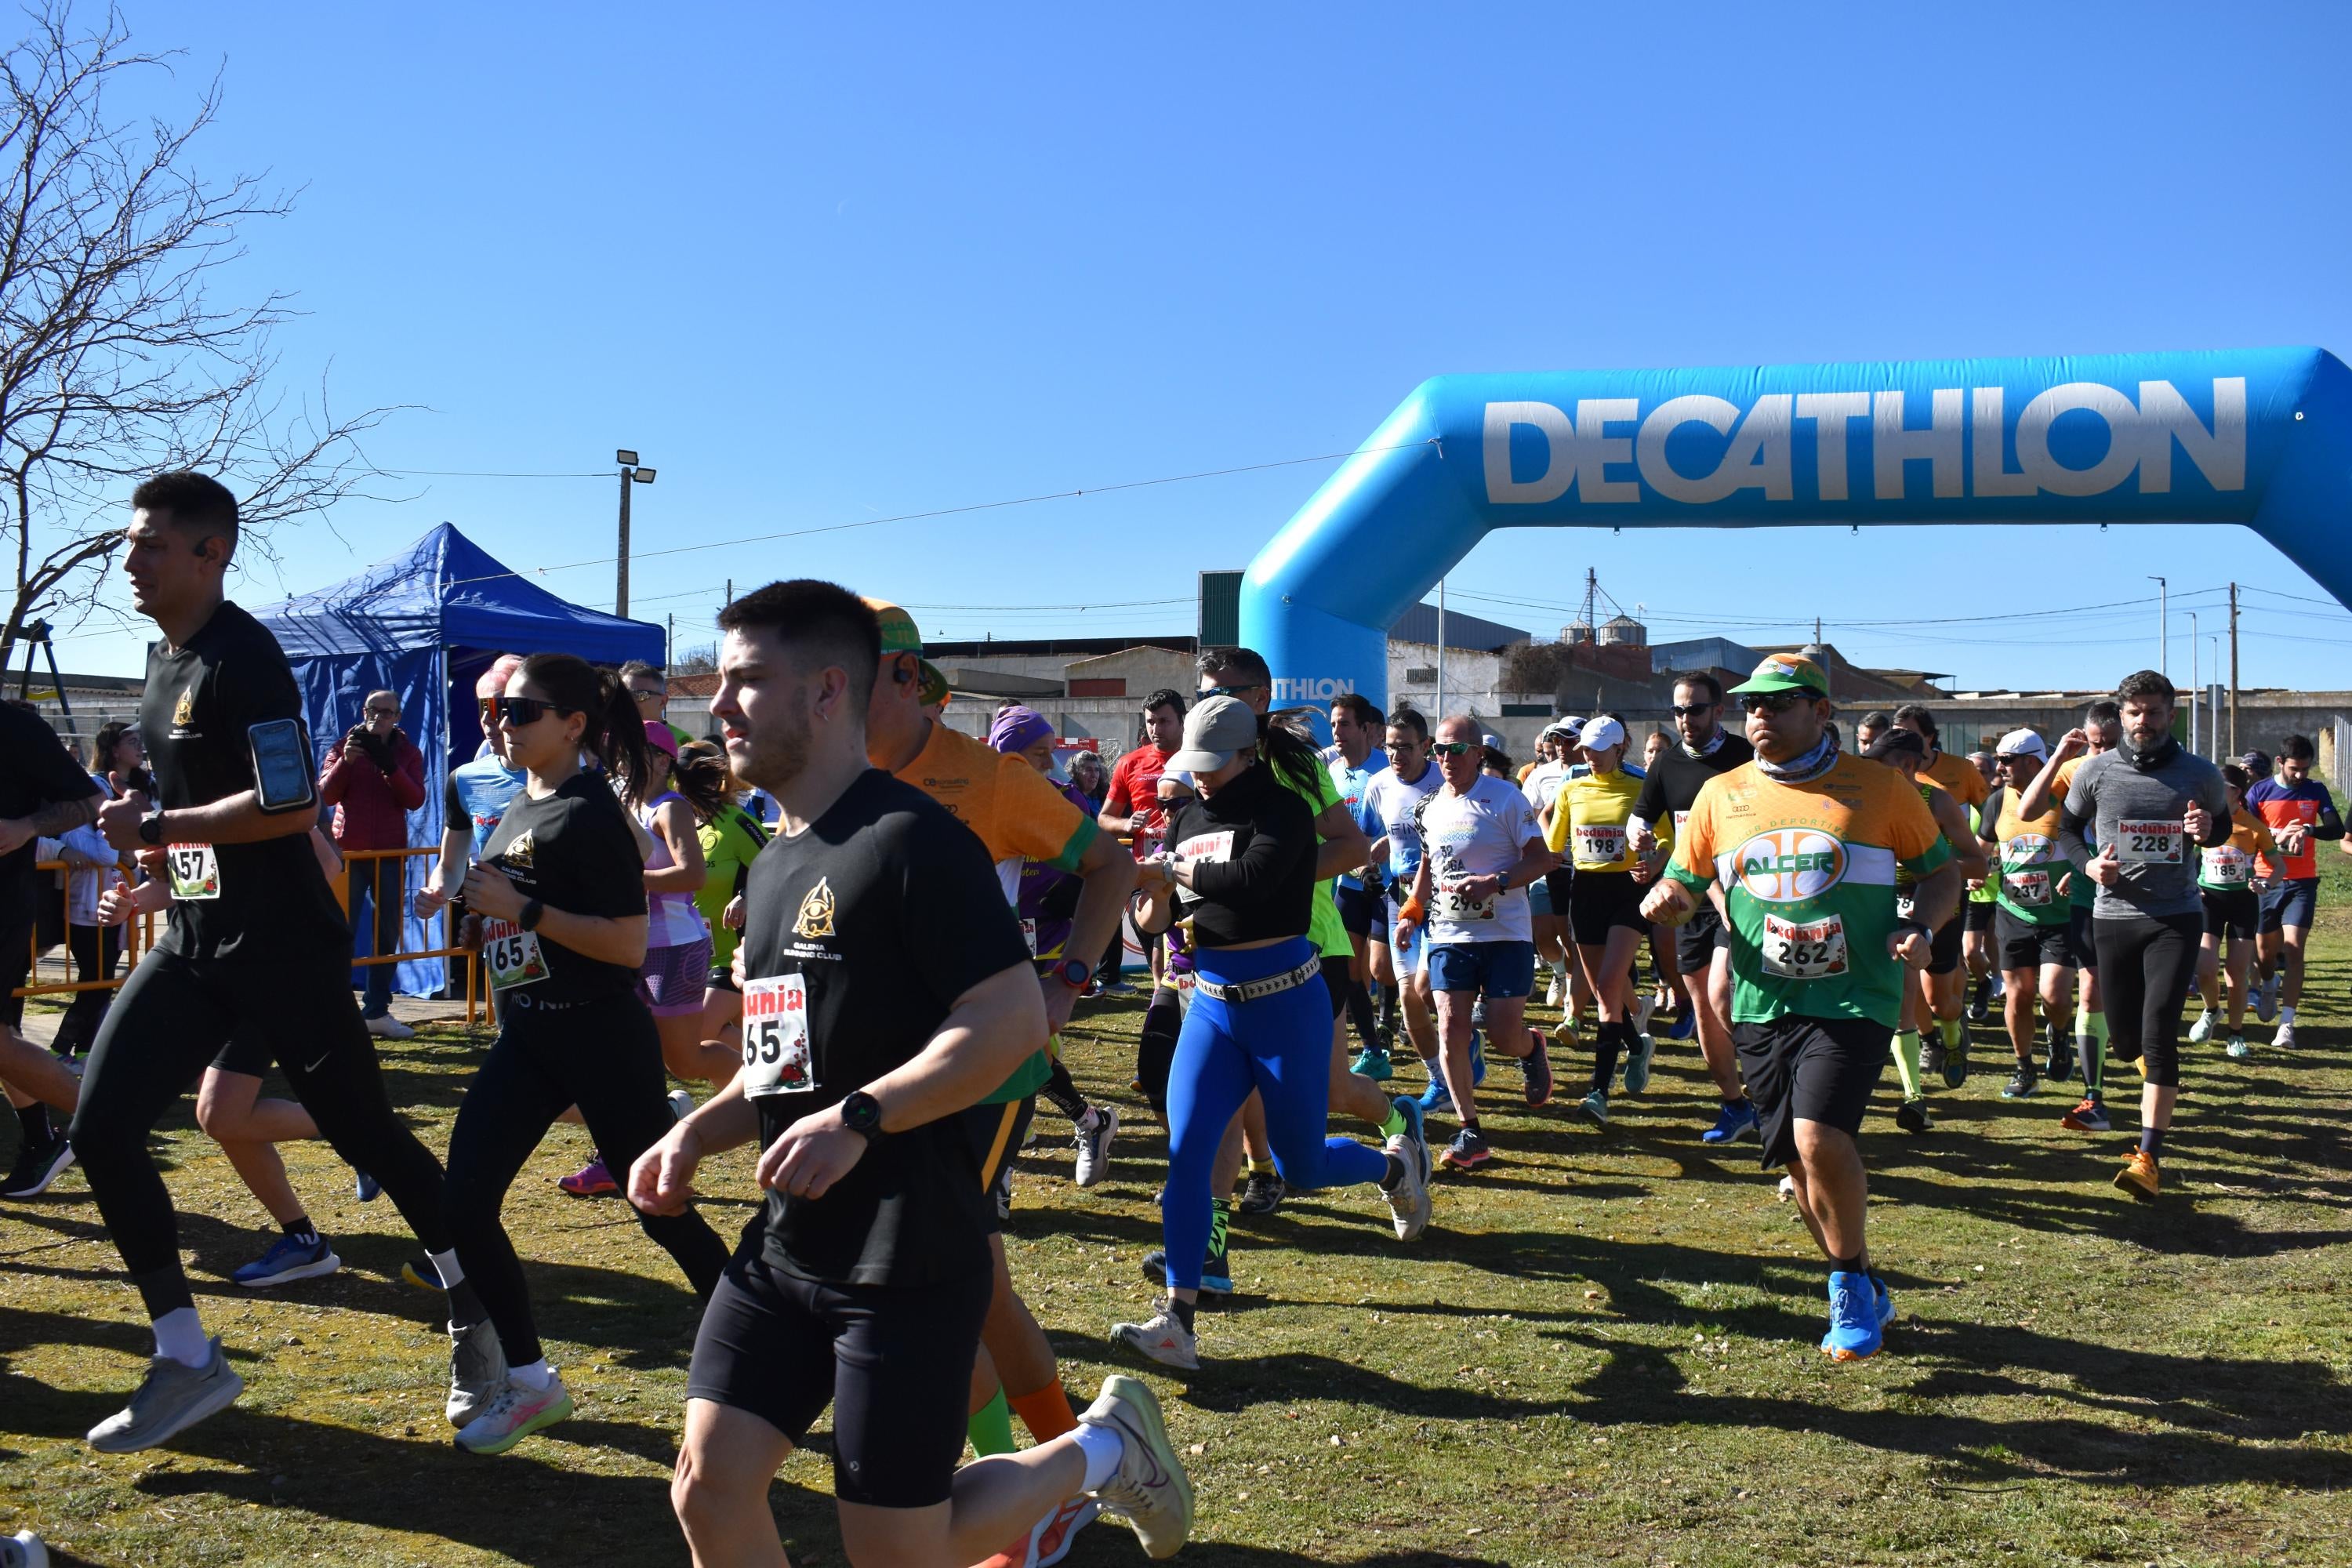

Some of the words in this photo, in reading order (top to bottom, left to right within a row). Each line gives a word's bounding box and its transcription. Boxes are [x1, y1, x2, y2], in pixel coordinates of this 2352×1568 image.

[1483, 377, 2246, 504] DECATHLON
[1576, 827, 1624, 837] bedunia
[1770, 818, 1850, 841] DEPORTIVO
[2120, 822, 2182, 834] bedunia
[1585, 839, 1615, 854] 198
[2131, 836, 2169, 852] 228
[1744, 852, 1835, 877] ALCER
[2214, 865, 2236, 876] 185
[2012, 884, 2040, 898] 237
[1766, 917, 1842, 942] bedunia
[487, 936, 524, 971] 165
[793, 942, 826, 952] GALENA
[1778, 942, 1830, 965] 262
[816, 952, 843, 960] CLUB
[743, 984, 804, 1018] unia
